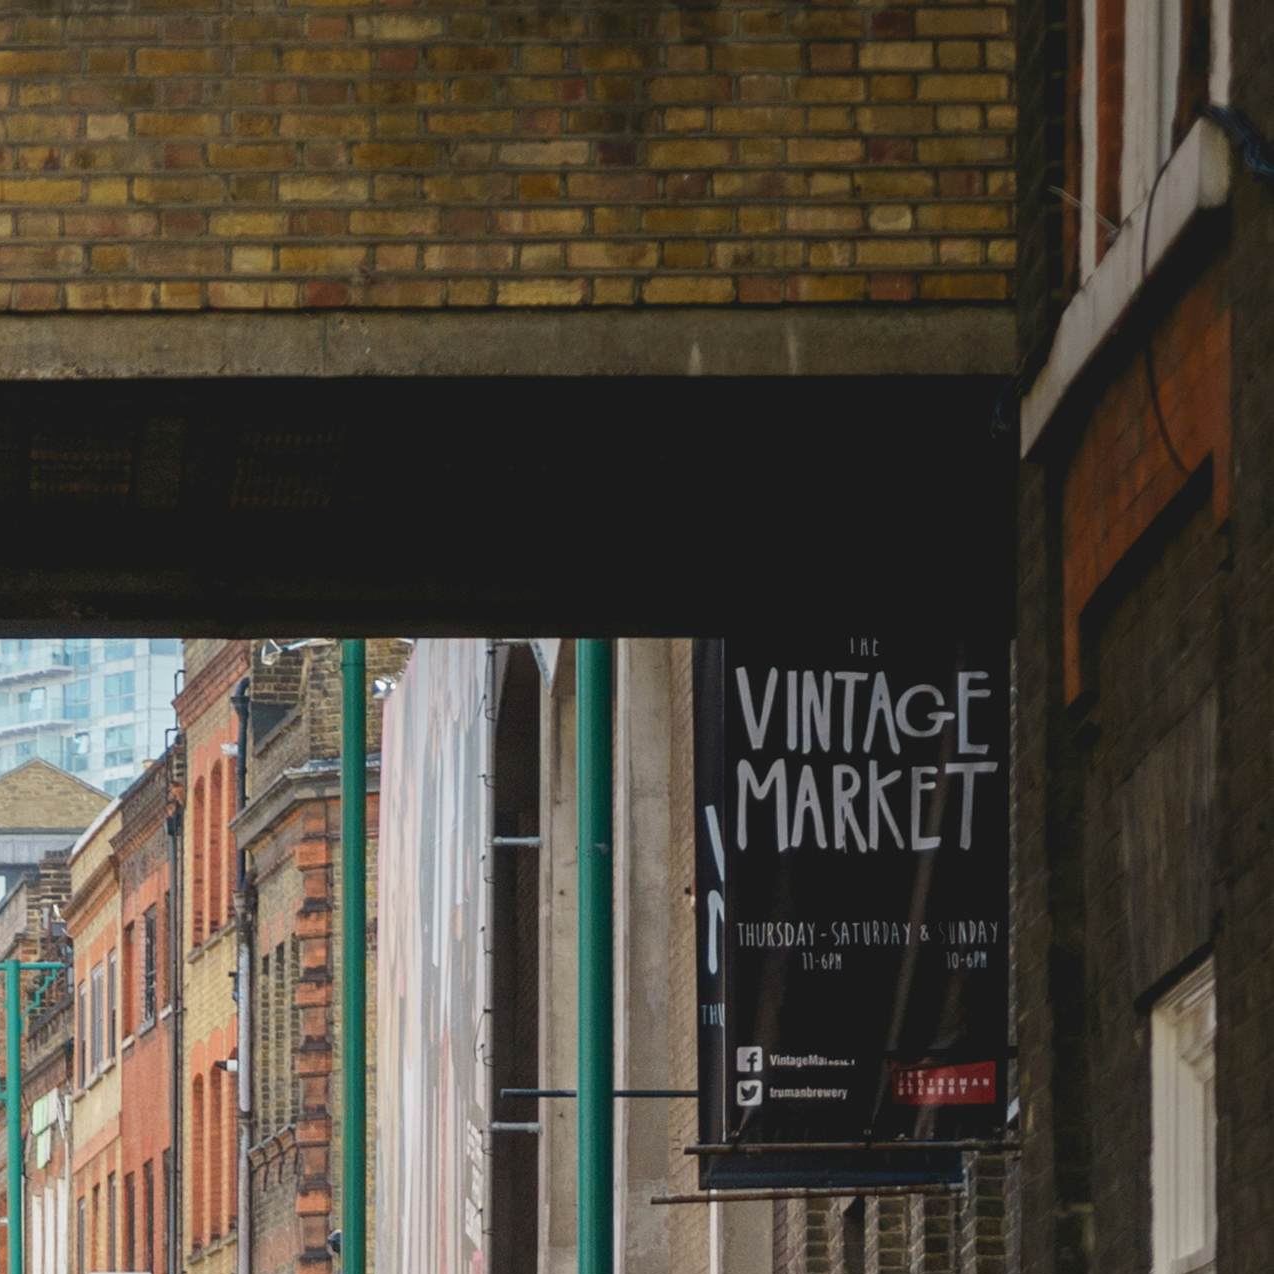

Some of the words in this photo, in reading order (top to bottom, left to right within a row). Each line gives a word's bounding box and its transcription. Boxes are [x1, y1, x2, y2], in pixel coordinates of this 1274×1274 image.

[735, 666, 991, 755] VINTAGE
[736, 758, 998, 853] MARKET
[737, 922, 815, 947] THURSDAY
[831, 921, 911, 947] SATURDAY
[938, 921, 998, 945] SUNDAY
[769, 1087, 848, 1100] trumanbrewery
